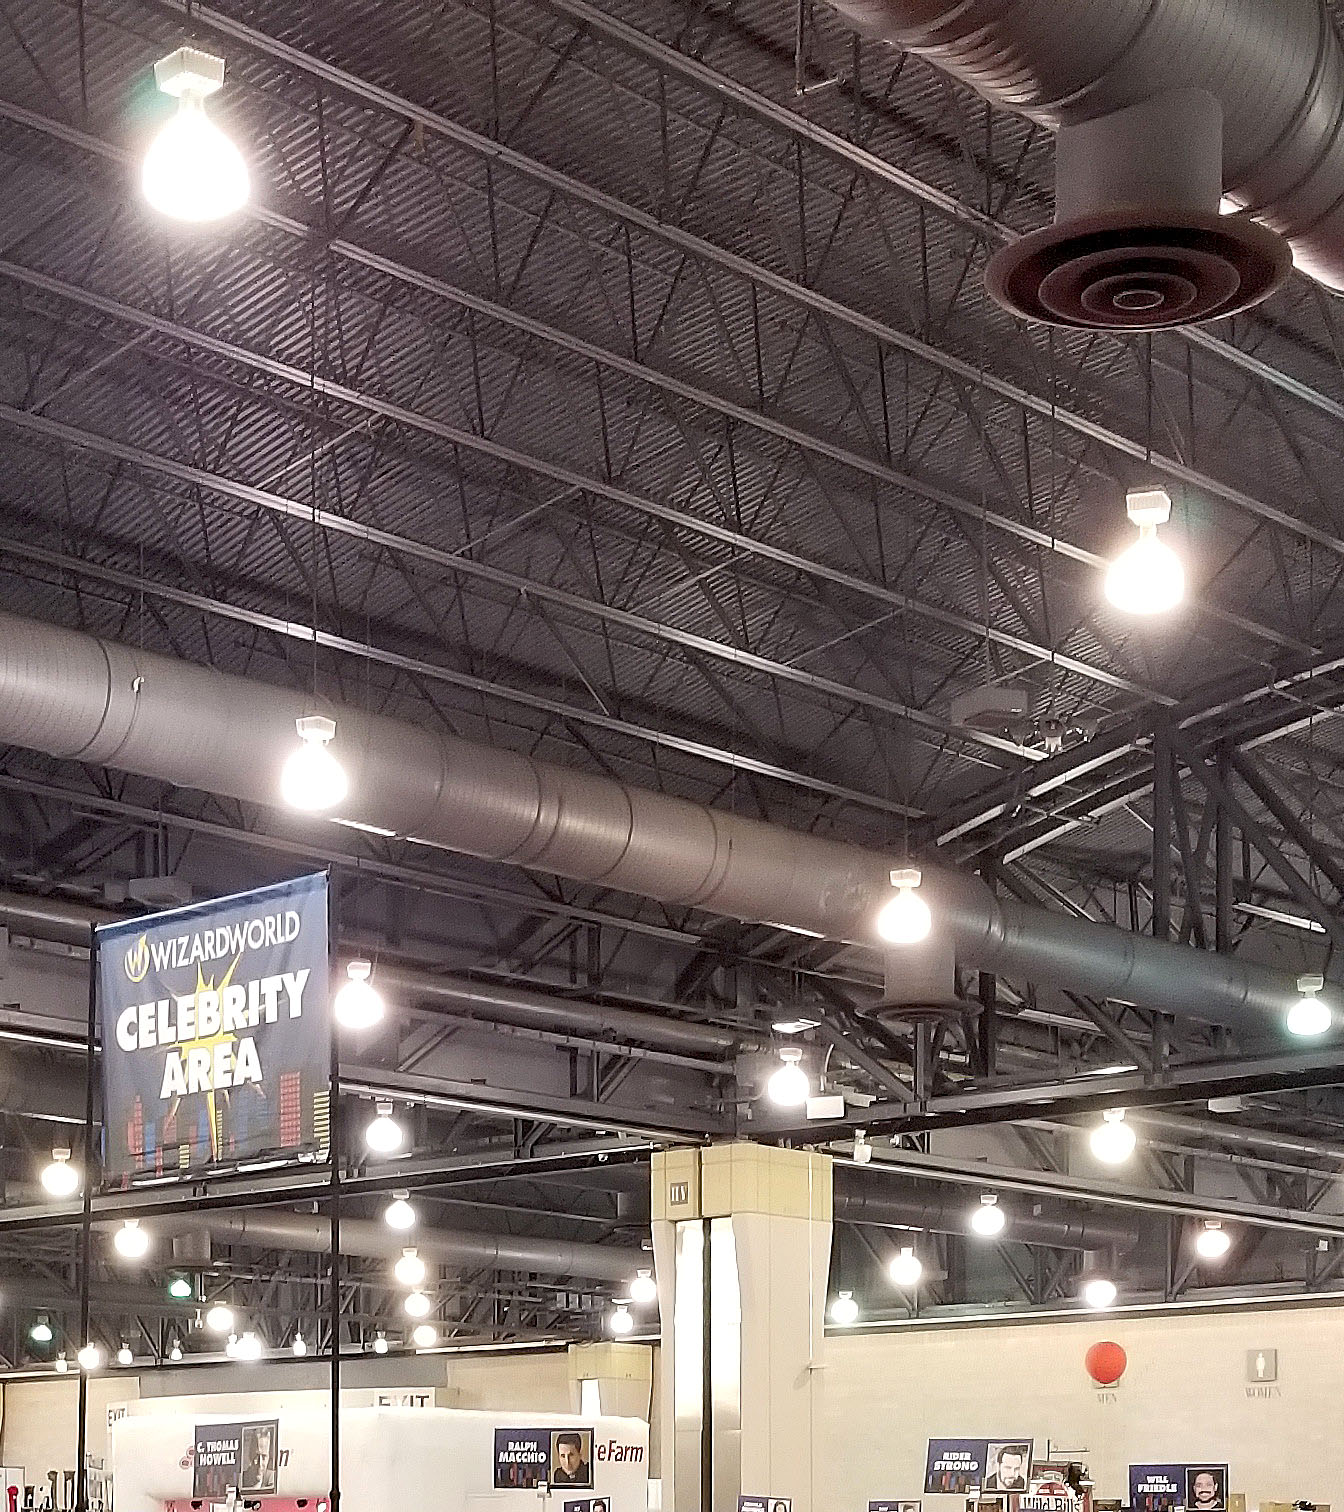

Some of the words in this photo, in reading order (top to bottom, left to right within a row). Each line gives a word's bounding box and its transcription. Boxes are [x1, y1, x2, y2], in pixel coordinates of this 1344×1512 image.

[152, 911, 300, 972] WIZARDWORLD
[115, 968, 311, 1052] CELEBRITY
[159, 1036, 264, 1100] AREA
[196, 1441, 206, 1454] C.
[207, 1439, 240, 1453] THOMAS
[507, 1440, 538, 1452] RALPH
[199, 1451, 236, 1467] HOWELL
[498, 1451, 547, 1464] MACCHIO
[1146, 1476, 1169, 1485] WILL
